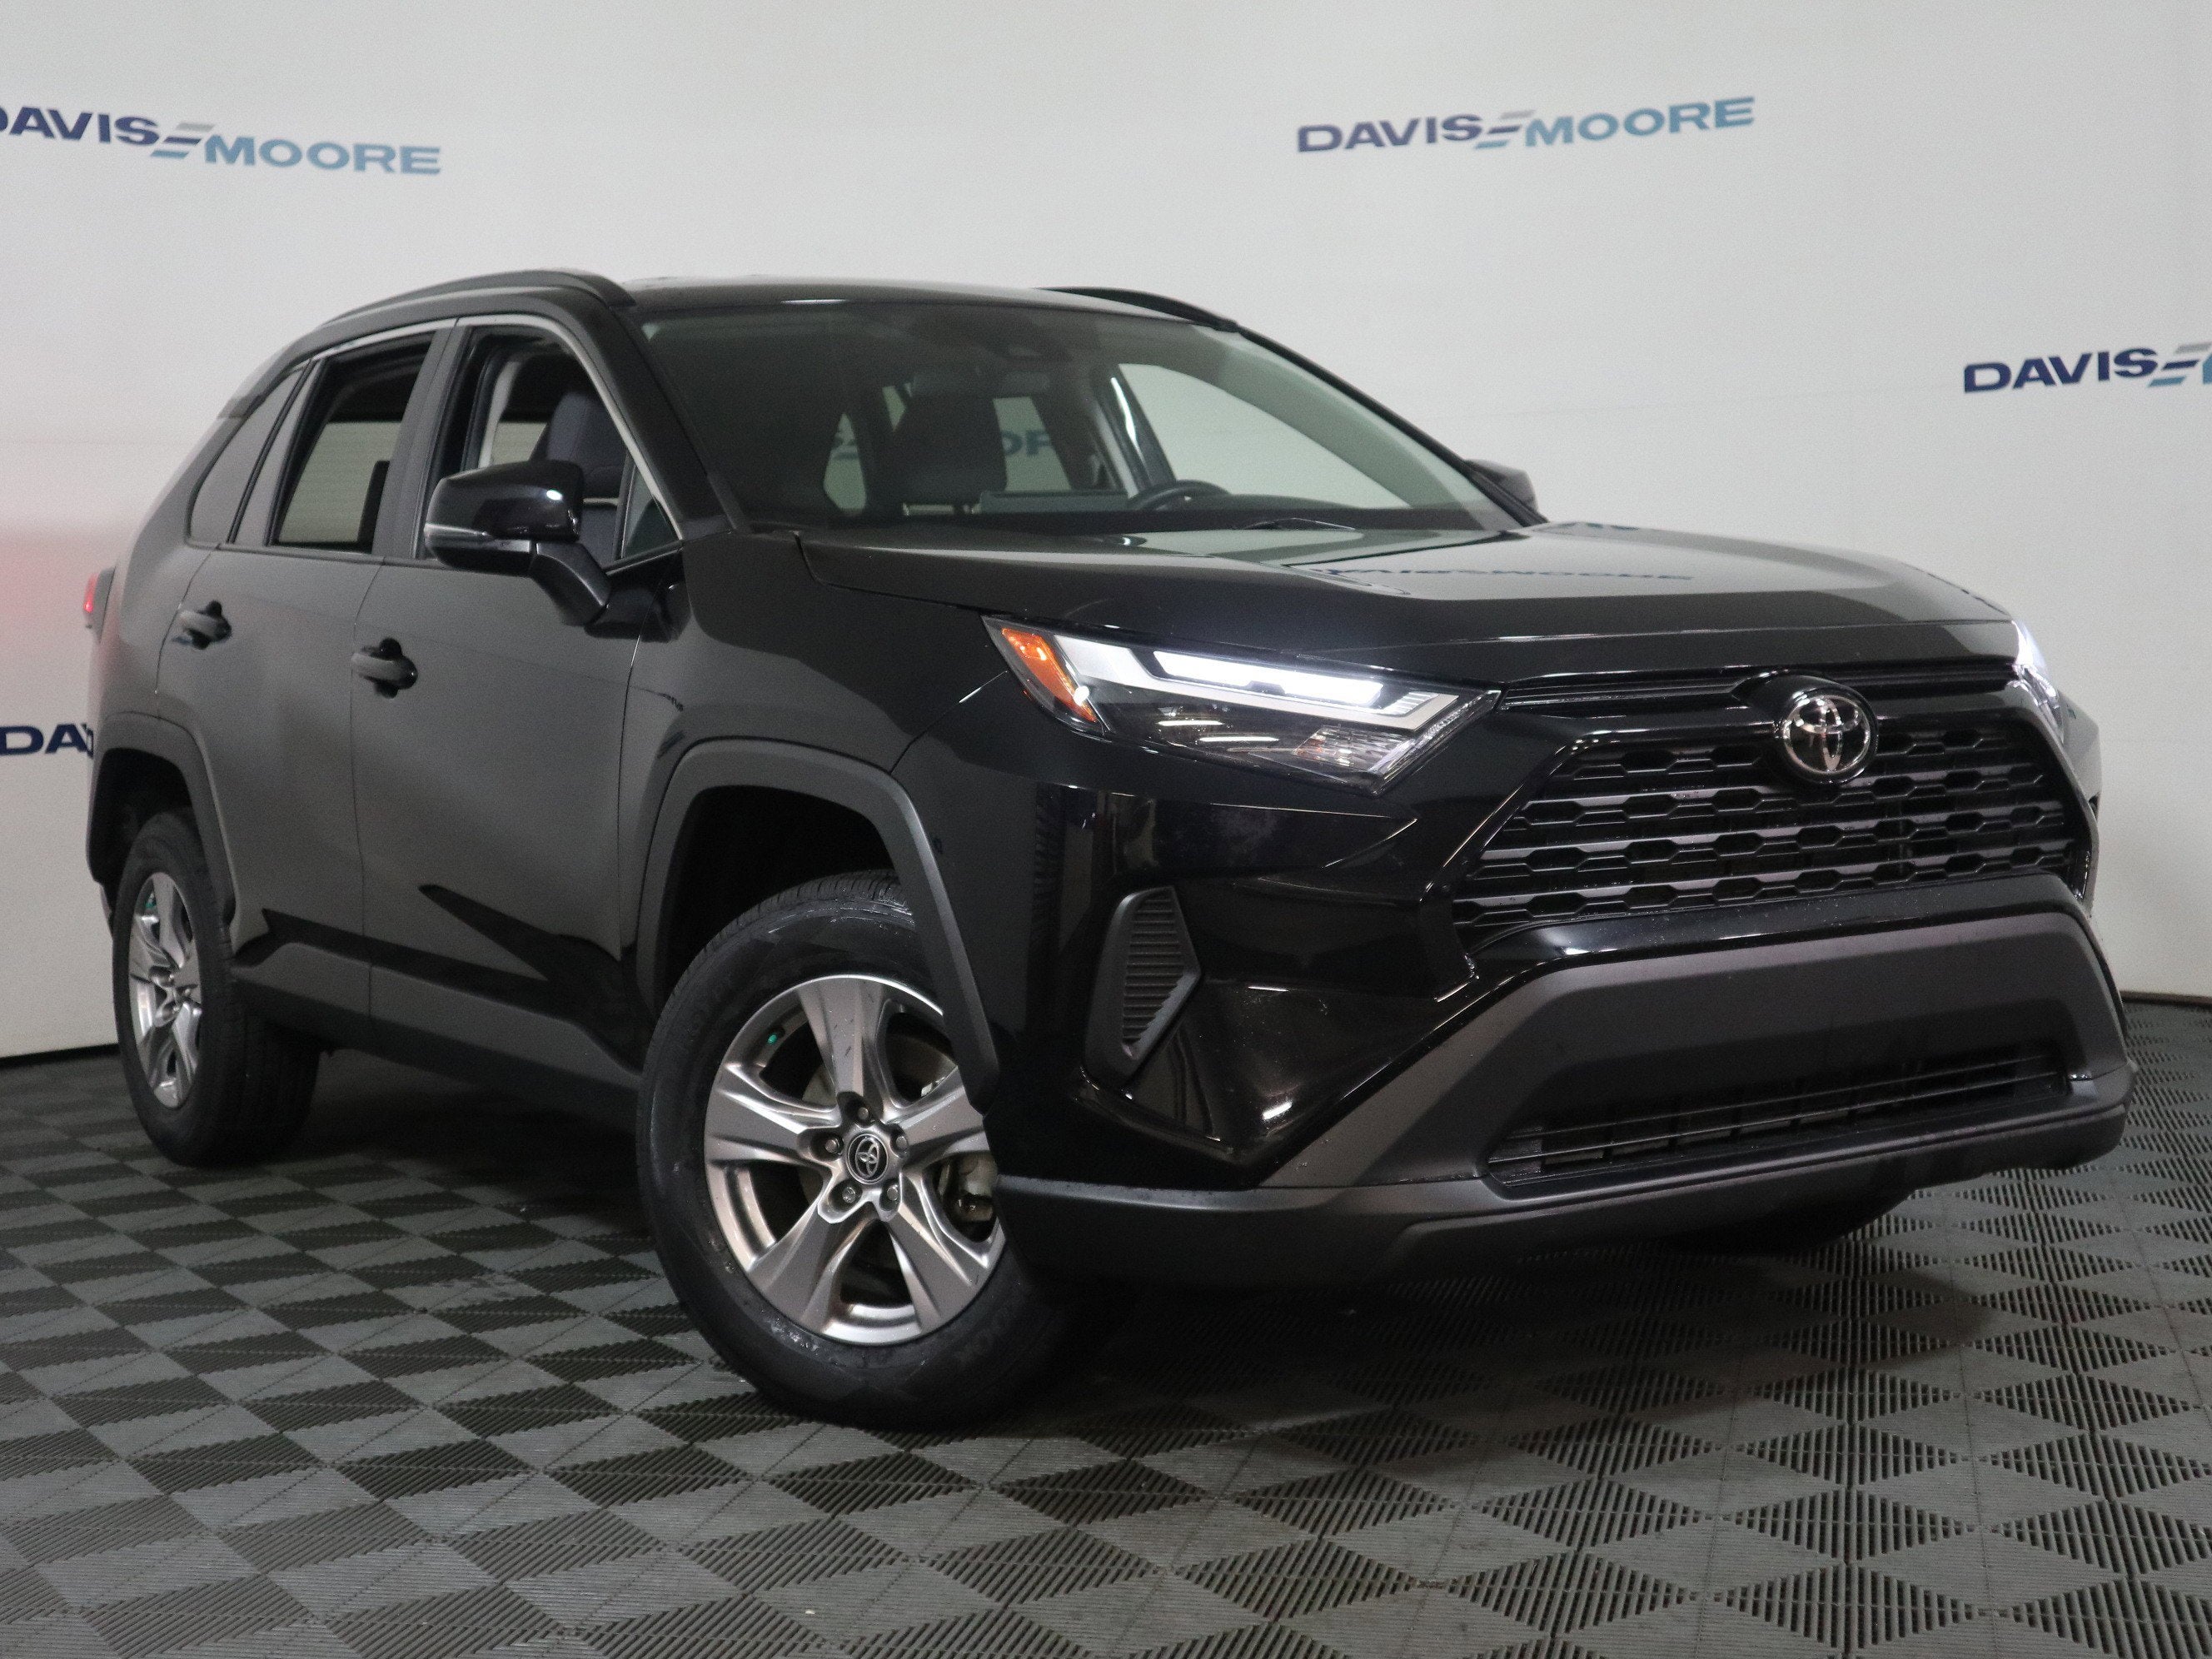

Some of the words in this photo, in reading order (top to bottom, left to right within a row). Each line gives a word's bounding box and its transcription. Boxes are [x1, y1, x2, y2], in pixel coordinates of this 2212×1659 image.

[0, 106, 160, 146] AVIS
[205, 134, 441, 176] MOORE
[1297, 113, 1483, 153] DAVIS
[1525, 96, 1756, 147] MOORE
[1964, 346, 2159, 393] DAVIS
